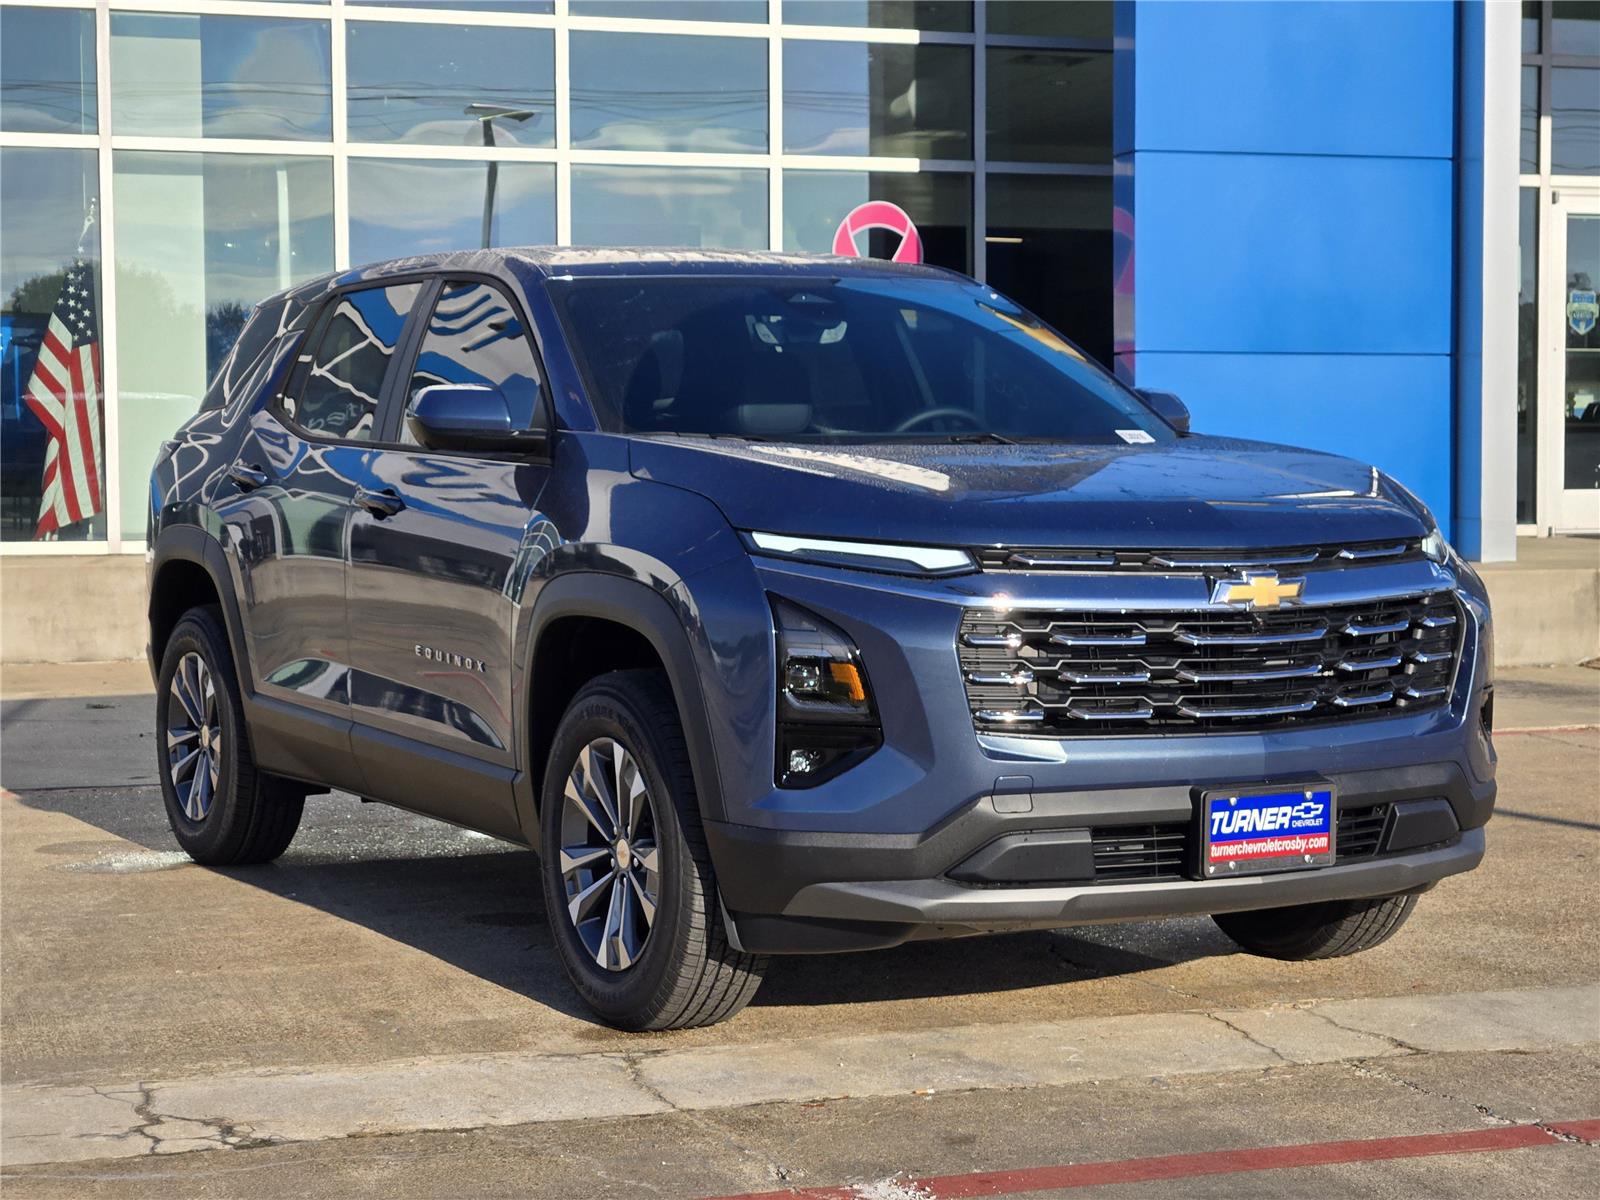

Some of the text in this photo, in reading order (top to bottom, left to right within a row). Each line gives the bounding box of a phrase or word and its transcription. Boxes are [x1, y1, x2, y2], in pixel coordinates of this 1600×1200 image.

[415, 644, 485, 673] EQUINOX
[1211, 805, 1292, 836] TURNER
[1291, 817, 1324, 829] CHEVROLET
[1210, 835, 1328, 858] turnerchevroletcrosby.com
